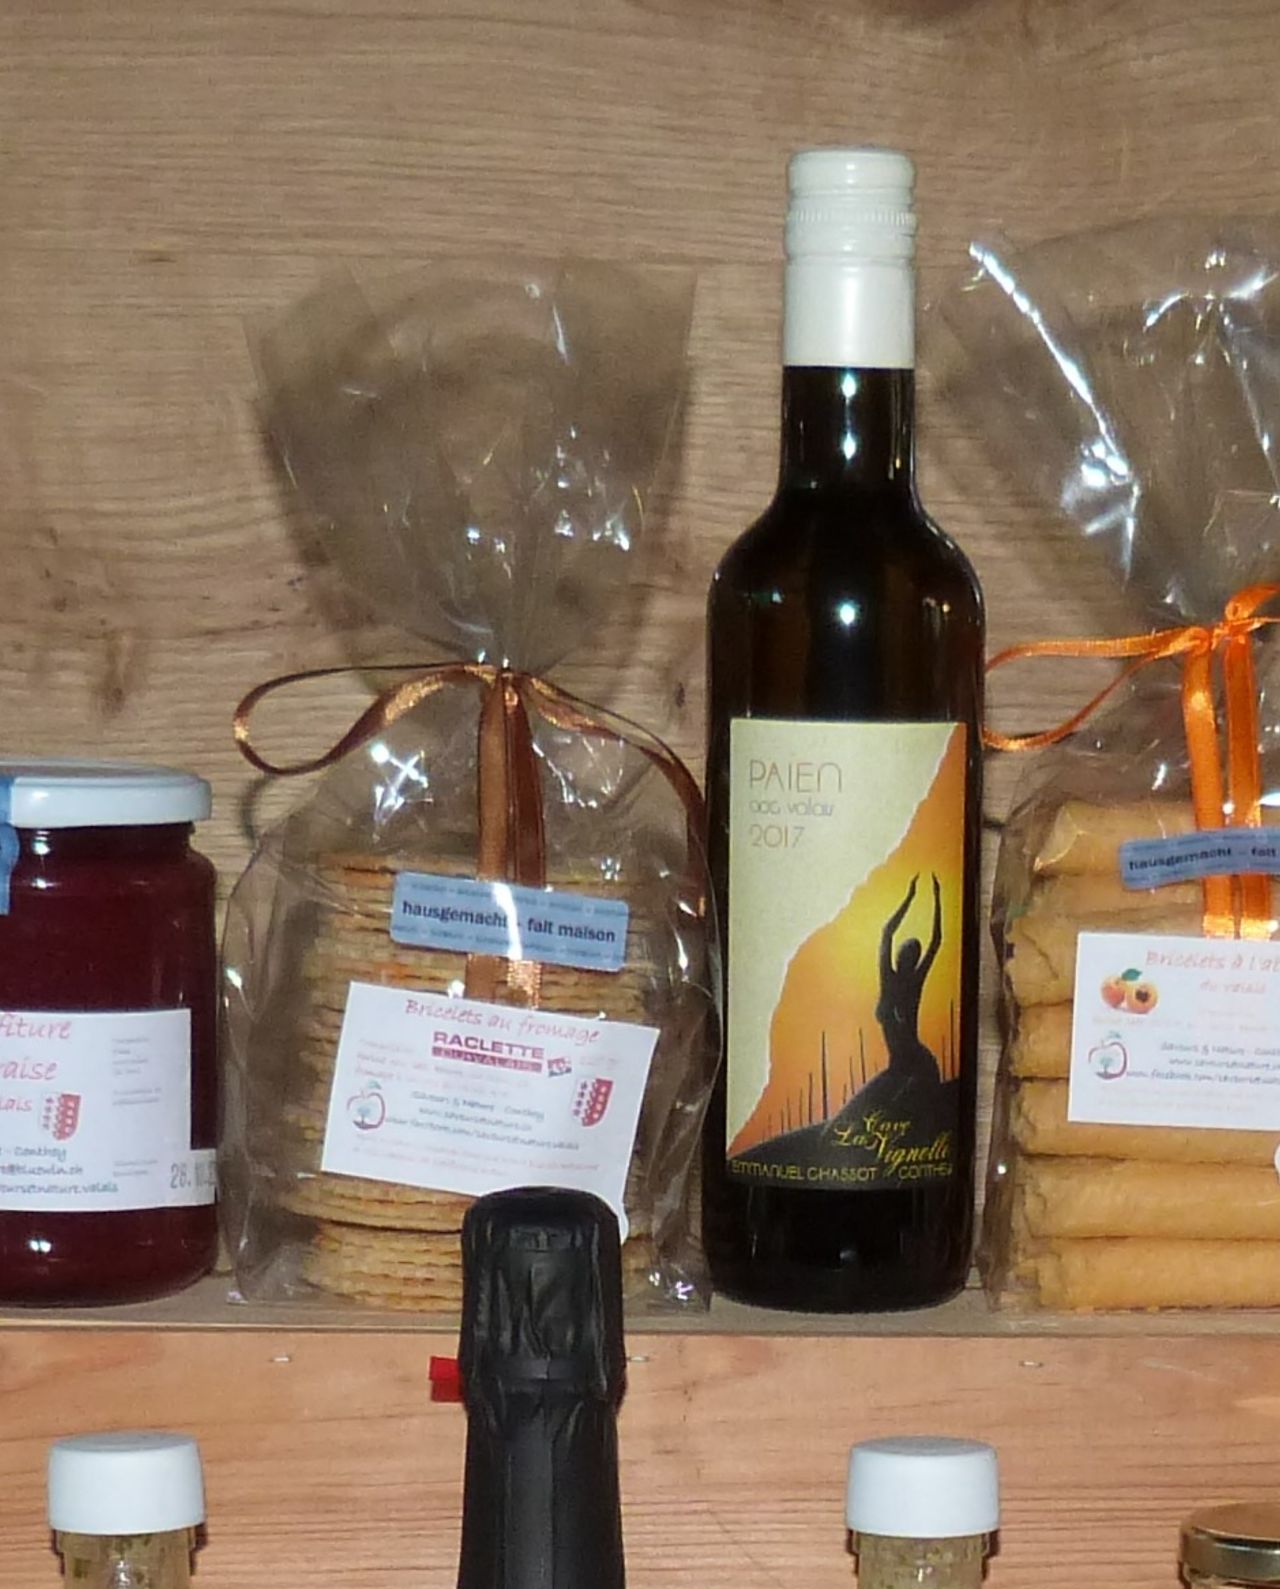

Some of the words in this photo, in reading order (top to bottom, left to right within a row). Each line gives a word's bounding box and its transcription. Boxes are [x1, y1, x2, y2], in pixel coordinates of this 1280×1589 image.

[750, 759, 842, 792] PAIEN
[750, 823, 805, 848] 2017
[1129, 847, 1233, 871] hausgemacht
[1251, 846, 1276, 858] fait
[402, 899, 507, 930] hausgemacht
[528, 917, 553, 933] fait
[557, 923, 615, 943] maison
[1145, 951, 1224, 970] Bricelets
[406, 999, 482, 1025] Bricelets
[487, 1015, 510, 1032] au
[518, 1015, 600, 1046] fromage
[433, 1031, 545, 1059] RACLETTE
[807, 1167, 878, 1181] CHASSOT
